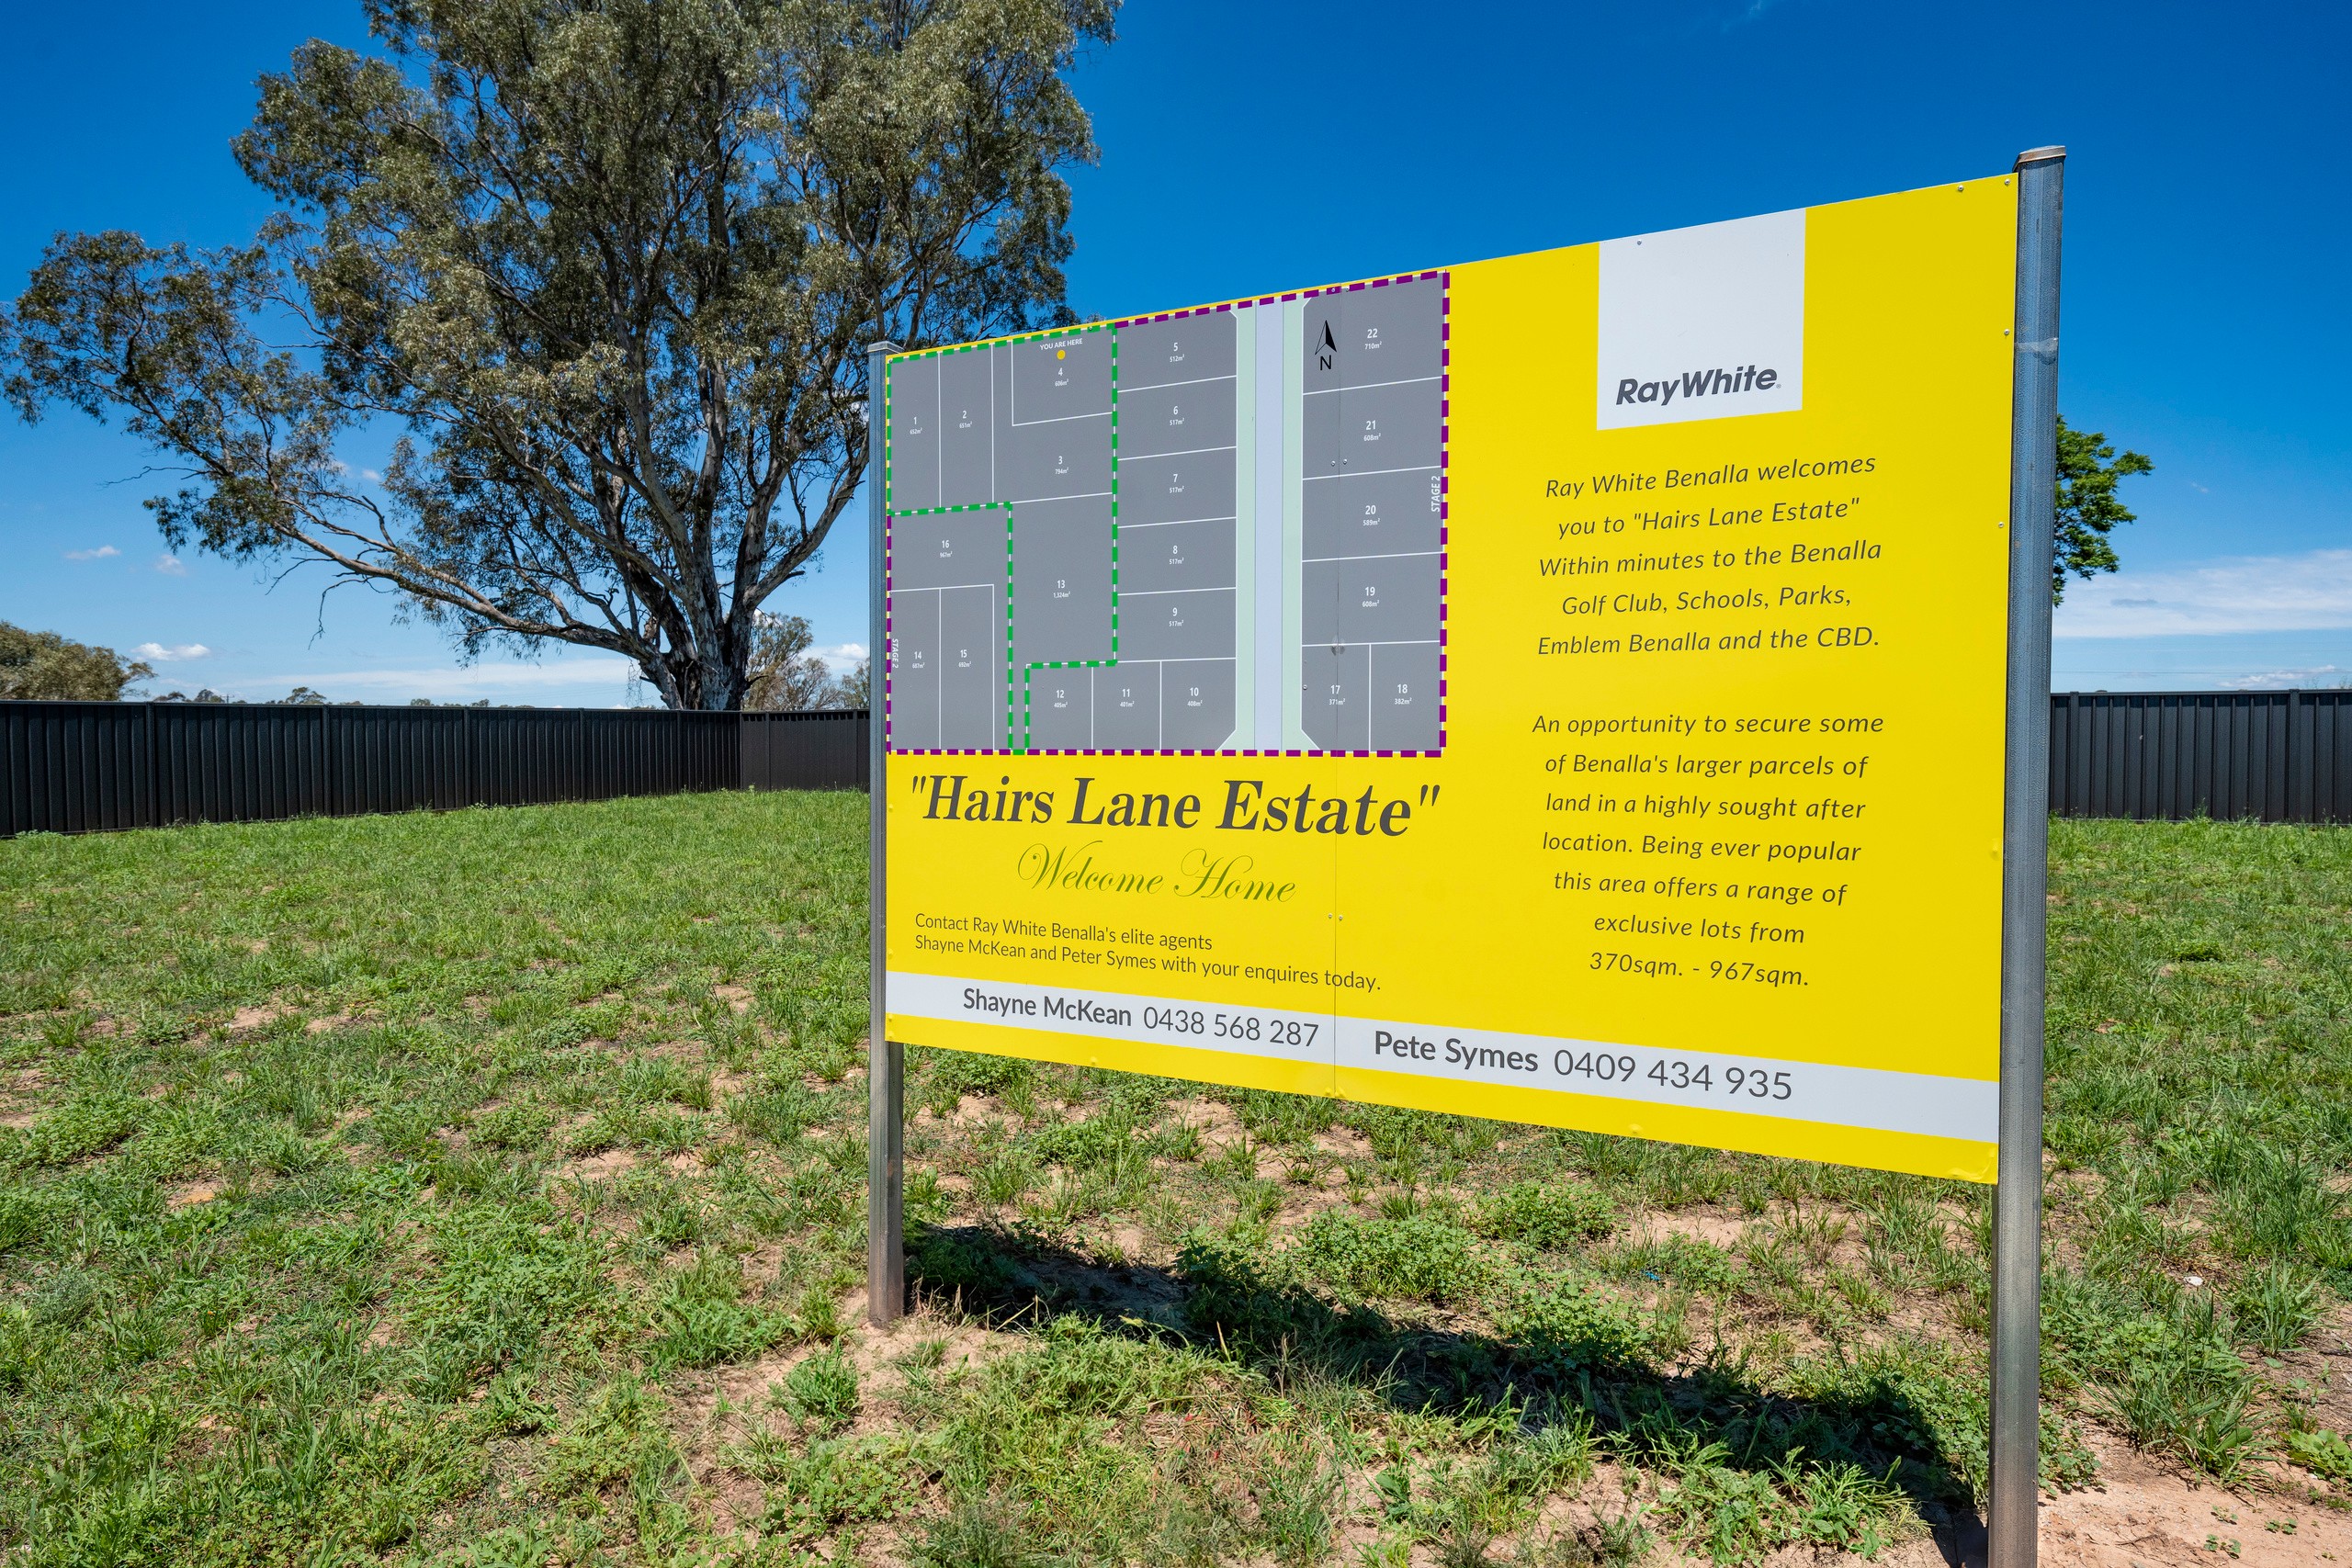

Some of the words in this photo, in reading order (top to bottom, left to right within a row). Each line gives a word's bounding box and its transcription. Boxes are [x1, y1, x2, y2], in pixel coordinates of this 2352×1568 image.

[1366, 328, 1378, 339] 22
[1039, 343, 1054, 351] YOU
[1054, 340, 1067, 349] ARE
[1067, 337, 1083, 346] HERE
[1173, 342, 1179, 352] 5
[1364, 340, 1383, 350] 710m²
[1169, 353, 1185, 363] 512m²
[1319, 354, 1332, 371] N
[1057, 367, 1064, 377] 4
[1616, 365, 1777, 406] RayWhite
[962, 410, 967, 420] 2
[1172, 405, 1179, 415] 6
[1169, 417, 1185, 426] 517m²
[1365, 419, 1376, 431] 21
[1363, 432, 1382, 442] 608m²
[1057, 455, 1063, 465] 3
[1172, 473, 1179, 483] 7
[1546, 480, 1584, 499] Ray
[1593, 473, 1656, 493] White
[1666, 465, 1748, 488] Benalla
[1758, 458, 1875, 480] welcomes
[1169, 485, 1185, 494] 517m²
[1430, 482, 1441, 513] STAGE
[1364, 504, 1377, 515] 20
[1559, 522, 1595, 539] you
[1604, 517, 1624, 533] to
[1634, 511, 1700, 530] "Hairs
[1709, 508, 1762, 525] Lane
[1772, 498, 1859, 522] Estate"
[941, 539, 950, 548] 16
[1172, 545, 1179, 555] 8
[1169, 557, 1184, 565] 517m²
[1540, 557, 1608, 576] Within
[1617, 553, 1703, 572] minutes
[1713, 550, 1735, 567] to
[1745, 547, 1781, 565] the
[1792, 540, 1881, 562] Benalla
[1057, 579, 1066, 589] 13
[1364, 586, 1376, 597] 19
[1362, 599, 1380, 608] 608m²
[1563, 595, 1607, 615] Golf
[1614, 593, 1667, 614] Club,
[1677, 589, 1768, 610] Schools,
[1780, 585, 1849, 606] Parks,
[1172, 606, 1178, 617] 9
[1169, 619, 1184, 627] 517m²
[1539, 636, 1620, 654] Emblem
[1629, 632, 1710, 651] Benalla
[1719, 630, 1761, 649] and
[1770, 629, 1807, 648] the
[1818, 627, 1878, 647] CBD.
[891, 637, 899, 662] STAGE
[913, 650, 922, 660] 14
[959, 649, 967, 659] 15
[1056, 689, 1065, 699] 12
[1122, 688, 1131, 698] 11
[1189, 686, 1200, 697] 10
[1330, 684, 1341, 694] 17
[1396, 683, 1408, 694] 18
[1394, 696, 1413, 705] 382m²
[1532, 716, 1559, 732] An
[1568, 715, 1696, 736] opportunity
[1704, 716, 1726, 732] to
[1735, 719, 1810, 732] secure
[1820, 718, 1883, 732] some
[1546, 754, 1566, 774] of
[1574, 755, 1668, 773] Benalla's
[1677, 755, 1742, 777] larger
[1749, 756, 1834, 778] parcels
[1843, 756, 1869, 778] of
[912, 775, 1054, 823] "Hairs
[1067, 778, 1200, 829] Lane
[1216, 781, 1440, 836] Estate"
[1547, 793, 1590, 811] land
[1599, 795, 1615, 812] in
[1624, 800, 1635, 812] a
[1645, 795, 1711, 818] highly
[1718, 797, 1797, 819] sought
[1806, 798, 1865, 820] after
[1544, 832, 1632, 852] location.
[1643, 836, 1703, 859] Being
[1712, 843, 1760, 857] ever
[1768, 841, 1861, 863] popular
[1018, 840, 1163, 893] Welcome
[1174, 850, 1295, 902] Home
[1555, 872, 1591, 890] this
[1600, 879, 1645, 893] area
[1654, 877, 1717, 897] offers
[1726, 885, 1738, 897] a
[1747, 886, 1813, 905] range
[1823, 885, 1848, 906] of
[916, 913, 968, 931] Contact
[974, 918, 998, 936] Ray
[1003, 919, 1046, 936] White
[1052, 923, 1115, 942] Benalla's
[1122, 929, 1154, 945] elite
[1159, 935, 1212, 951] agents
[1595, 915, 1691, 935] exclusive
[1702, 919, 1741, 939] lots
[1750, 922, 1804, 942] from
[916, 935, 964, 953] Shayne
[969, 939, 1025, 957] McKean
[1031, 946, 1056, 960] and
[1063, 947, 1102, 964] Peter
[1107, 951, 1156, 969] Symes
[1161, 956, 1195, 973] with
[1202, 963, 1239, 977] your
[1245, 965, 1317, 984] enquires
[1325, 970, 1380, 993] today.
[1590, 953, 1682, 977] 370sqm.
[1711, 961, 1807, 987] 967sqm.
[964, 988, 1036, 1017] Shayne
[1045, 996, 1131, 1026] McKean
[1144, 1007, 1204, 1034] 0438
[1215, 1014, 1260, 1041] 568
[1270, 1021, 1318, 1046] 287
[1375, 1031, 1435, 1060] Pete
[1445, 1038, 1538, 1071] Symes
[1555, 1050, 1635, 1081] 0409
[1647, 1060, 1713, 1091] 434
[1726, 1067, 1792, 1100] 935
